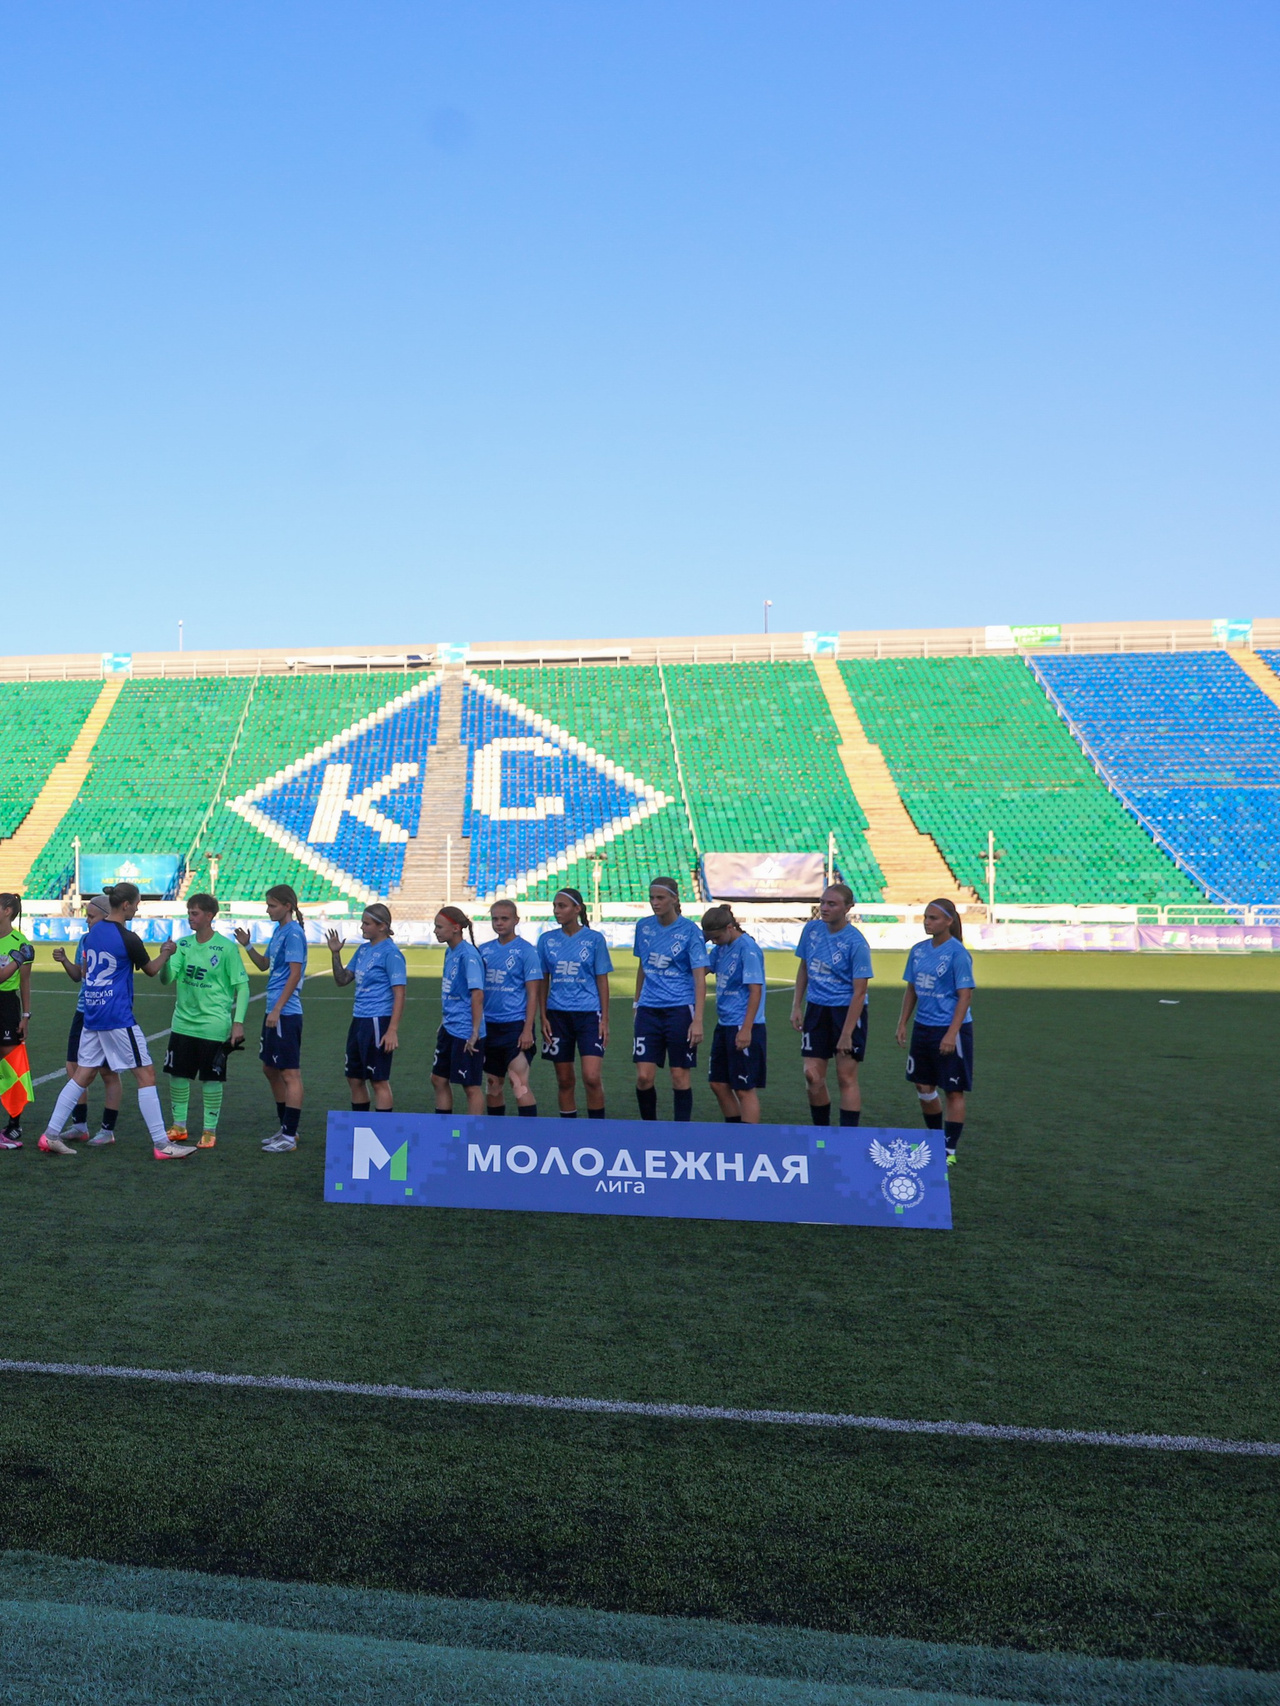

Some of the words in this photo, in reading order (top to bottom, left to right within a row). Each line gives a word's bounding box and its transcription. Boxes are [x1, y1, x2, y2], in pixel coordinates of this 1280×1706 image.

[307, 762, 419, 843] К
[472, 736, 564, 821] С
[86, 949, 117, 987] 22
[467, 1143, 810, 1185] МОЛОДЕЖНАЯ
